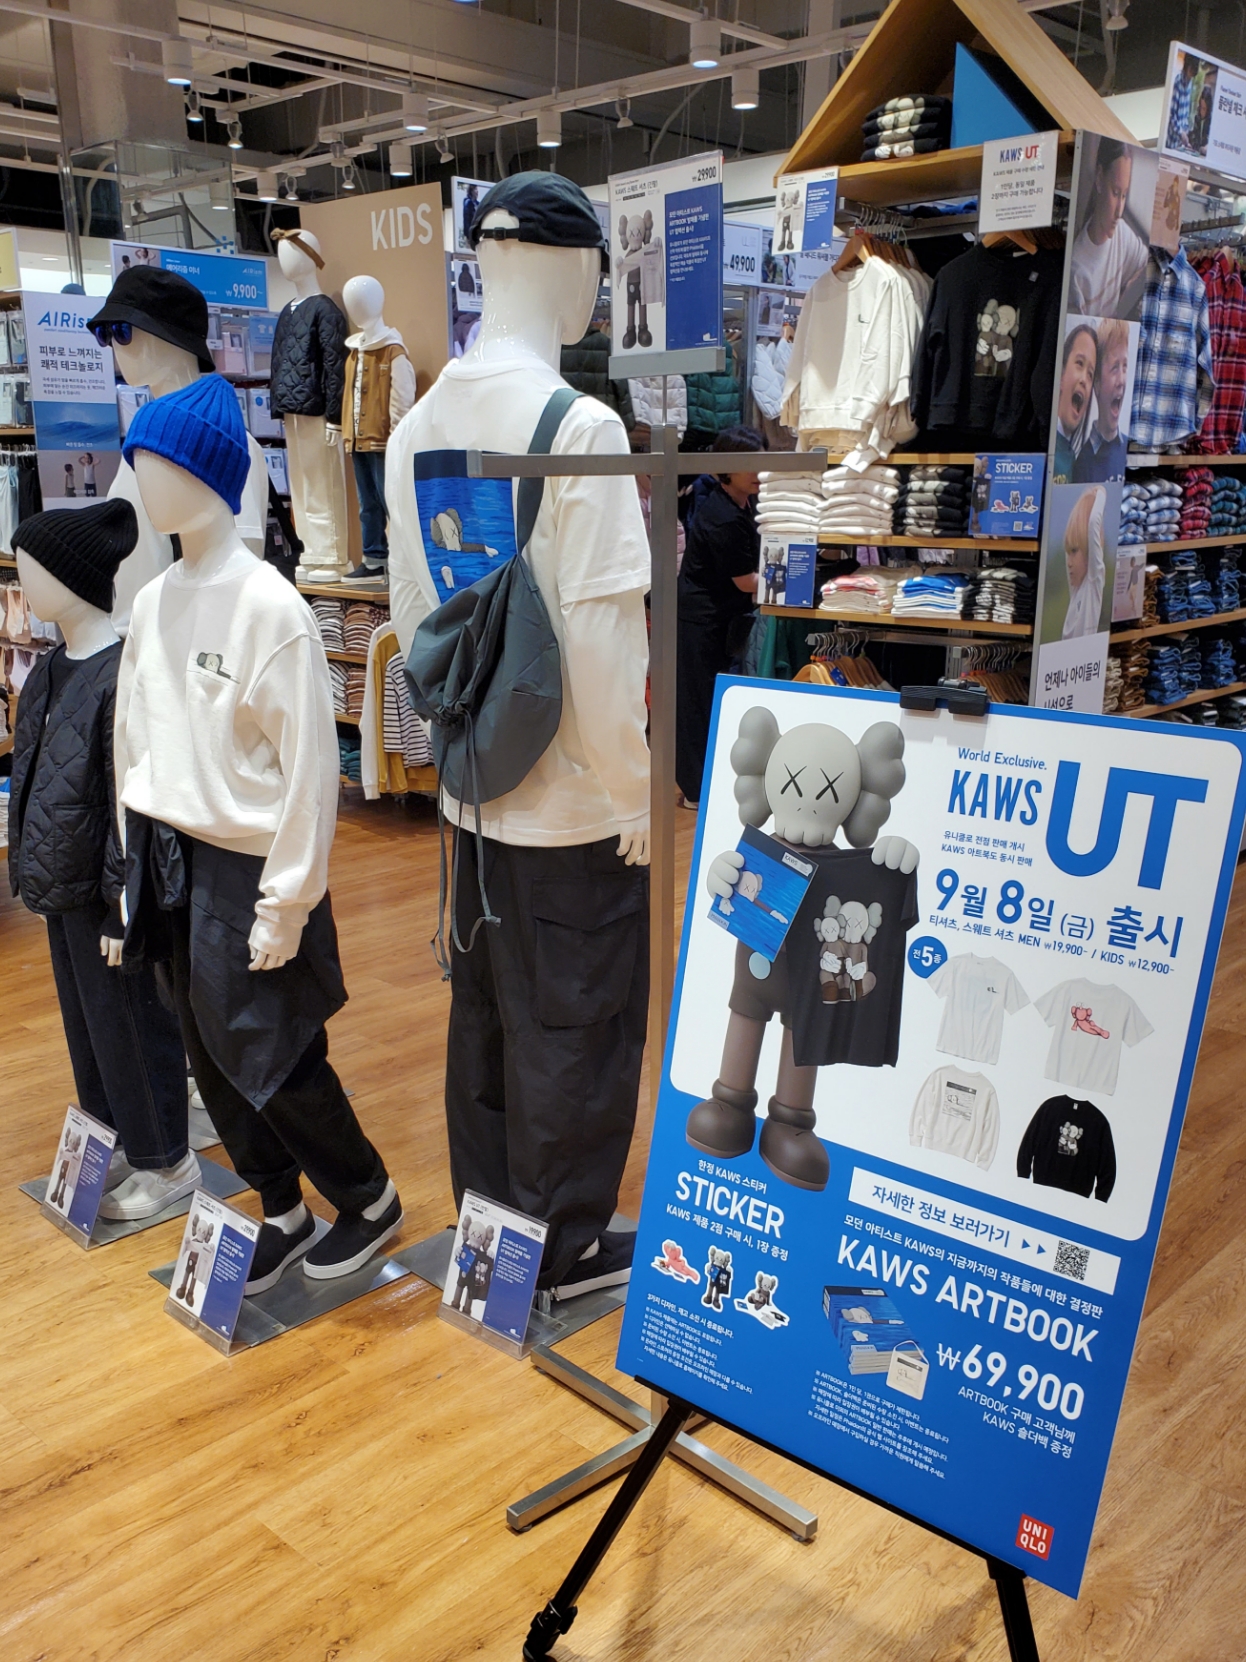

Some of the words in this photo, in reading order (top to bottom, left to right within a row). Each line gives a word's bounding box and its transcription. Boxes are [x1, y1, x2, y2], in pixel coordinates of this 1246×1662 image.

[1000, 147, 1022, 163] KAWS
[1026, 145, 1039, 159] UT
[370, 202, 433, 250] KIDS
[38, 310, 94, 329] AIRis
[39, 345, 66, 357] 피부로
[68, 347, 103, 360] 느껴지는
[40, 359, 59, 372] 쾌적
[60, 360, 104, 373] 테크놀로지
[995, 463, 1033, 473] STICKER
[1044, 666, 1068, 692] 언제나
[1070, 660, 1101, 685] 아이들의
[957, 747, 990, 762] World
[994, 752, 1047, 770] Exclusive.
[948, 769, 1042, 826] KAWS
[944, 830, 973, 843] 유니클로
[992, 838, 1008, 849] 판매
[1009, 842, 1025, 852] 개시
[1045, 760, 1209, 891] UT
[941, 844, 965, 854] KAWS
[968, 848, 997, 860] 아트북도
[999, 853, 1015, 864] 동시
[1017, 856, 1033, 867] 판매
[936, 868, 987, 919] 9월
[996, 880, 1055, 933] 8일
[1060, 913, 1095, 941] (금)
[1106, 905, 1184, 959] 출시
[929, 915, 960, 932] 티셔츠,
[994, 928, 1014, 941] 셔츠
[1018, 933, 1041, 947] MEN
[1100, 950, 1125, 965] KIDS
[698, 1159, 714, 1175] 한정
[715, 1166, 741, 1184] KAWS
[742, 1176, 767, 1194] 스티커
[675, 1171, 785, 1238] STICKER
[872, 1185, 915, 1214] 자세한
[919, 1201, 947, 1225] 정보
[949, 1210, 1012, 1248] 보러가기
[666, 1203, 690, 1221] KAWS
[692, 1213, 709, 1229] 제품
[710, 1221, 723, 1235] 2점
[724, 1226, 742, 1243] 구매
[742, 1235, 754, 1248] 시,
[756, 1240, 769, 1254] 1장
[771, 1245, 789, 1261] 증정
[844, 1214, 864, 1232] 모던
[865, 1221, 902, 1245] 아티스트
[904, 1236, 945, 1262] KAWS의
[946, 1249, 998, 1280] 지금까지의
[1000, 1270, 1043, 1297] 작품들에
[1045, 1286, 1067, 1306] 대한
[1069, 1296, 1104, 1320] 결정판
[837, 1233, 930, 1296] KAWS
[935, 1274, 1099, 1362] ARTBOOK
[936, 1342, 1085, 1420] ₩69,900
[958, 1386, 1008, 1416] ARTBOOK
[1010, 1407, 1032, 1425] 구매
[1033, 1416, 1076, 1444] 고객님께
[982, 1411, 1015, 1434] KAWS
[1017, 1427, 1048, 1449] 숄더백
[1050, 1439, 1072, 1459] 증정
[1020, 1533, 1046, 1553] QLO
[1022, 1519, 1048, 1540] UNI
